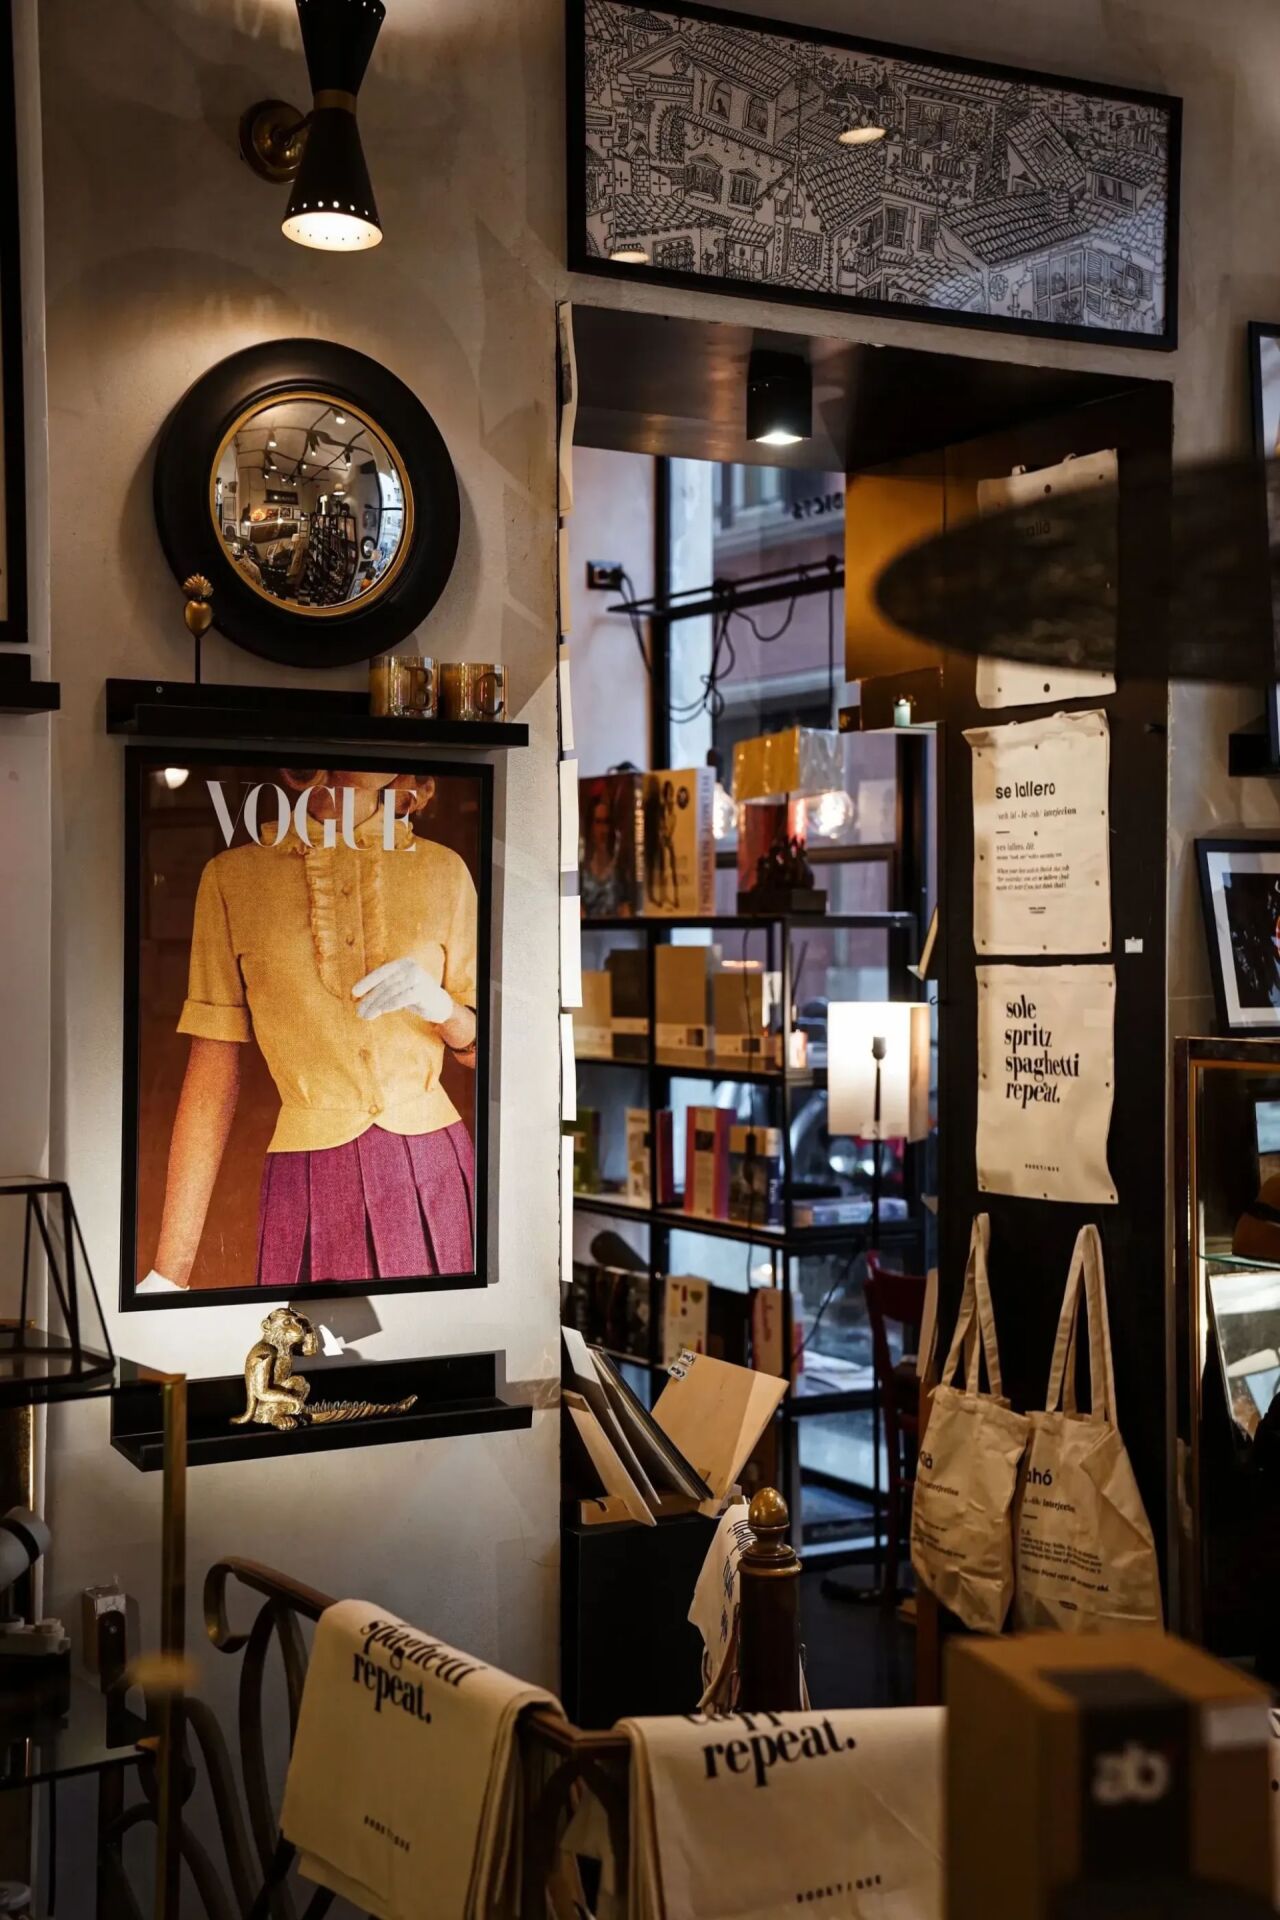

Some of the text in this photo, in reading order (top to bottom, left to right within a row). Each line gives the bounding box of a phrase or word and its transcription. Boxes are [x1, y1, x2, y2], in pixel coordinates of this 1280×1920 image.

[995, 781, 1056, 800] se lallero
[206, 780, 417, 853] VOGUE
[1006, 994, 1037, 1019] sole
[1004, 1023, 1053, 1054] spritz
[1005, 1050, 1080, 1082] spaghetti
[1005, 1082, 1061, 1109] repeat.
[353, 1653, 432, 1724] repeat.
[701, 1716, 856, 1787] repeat.
